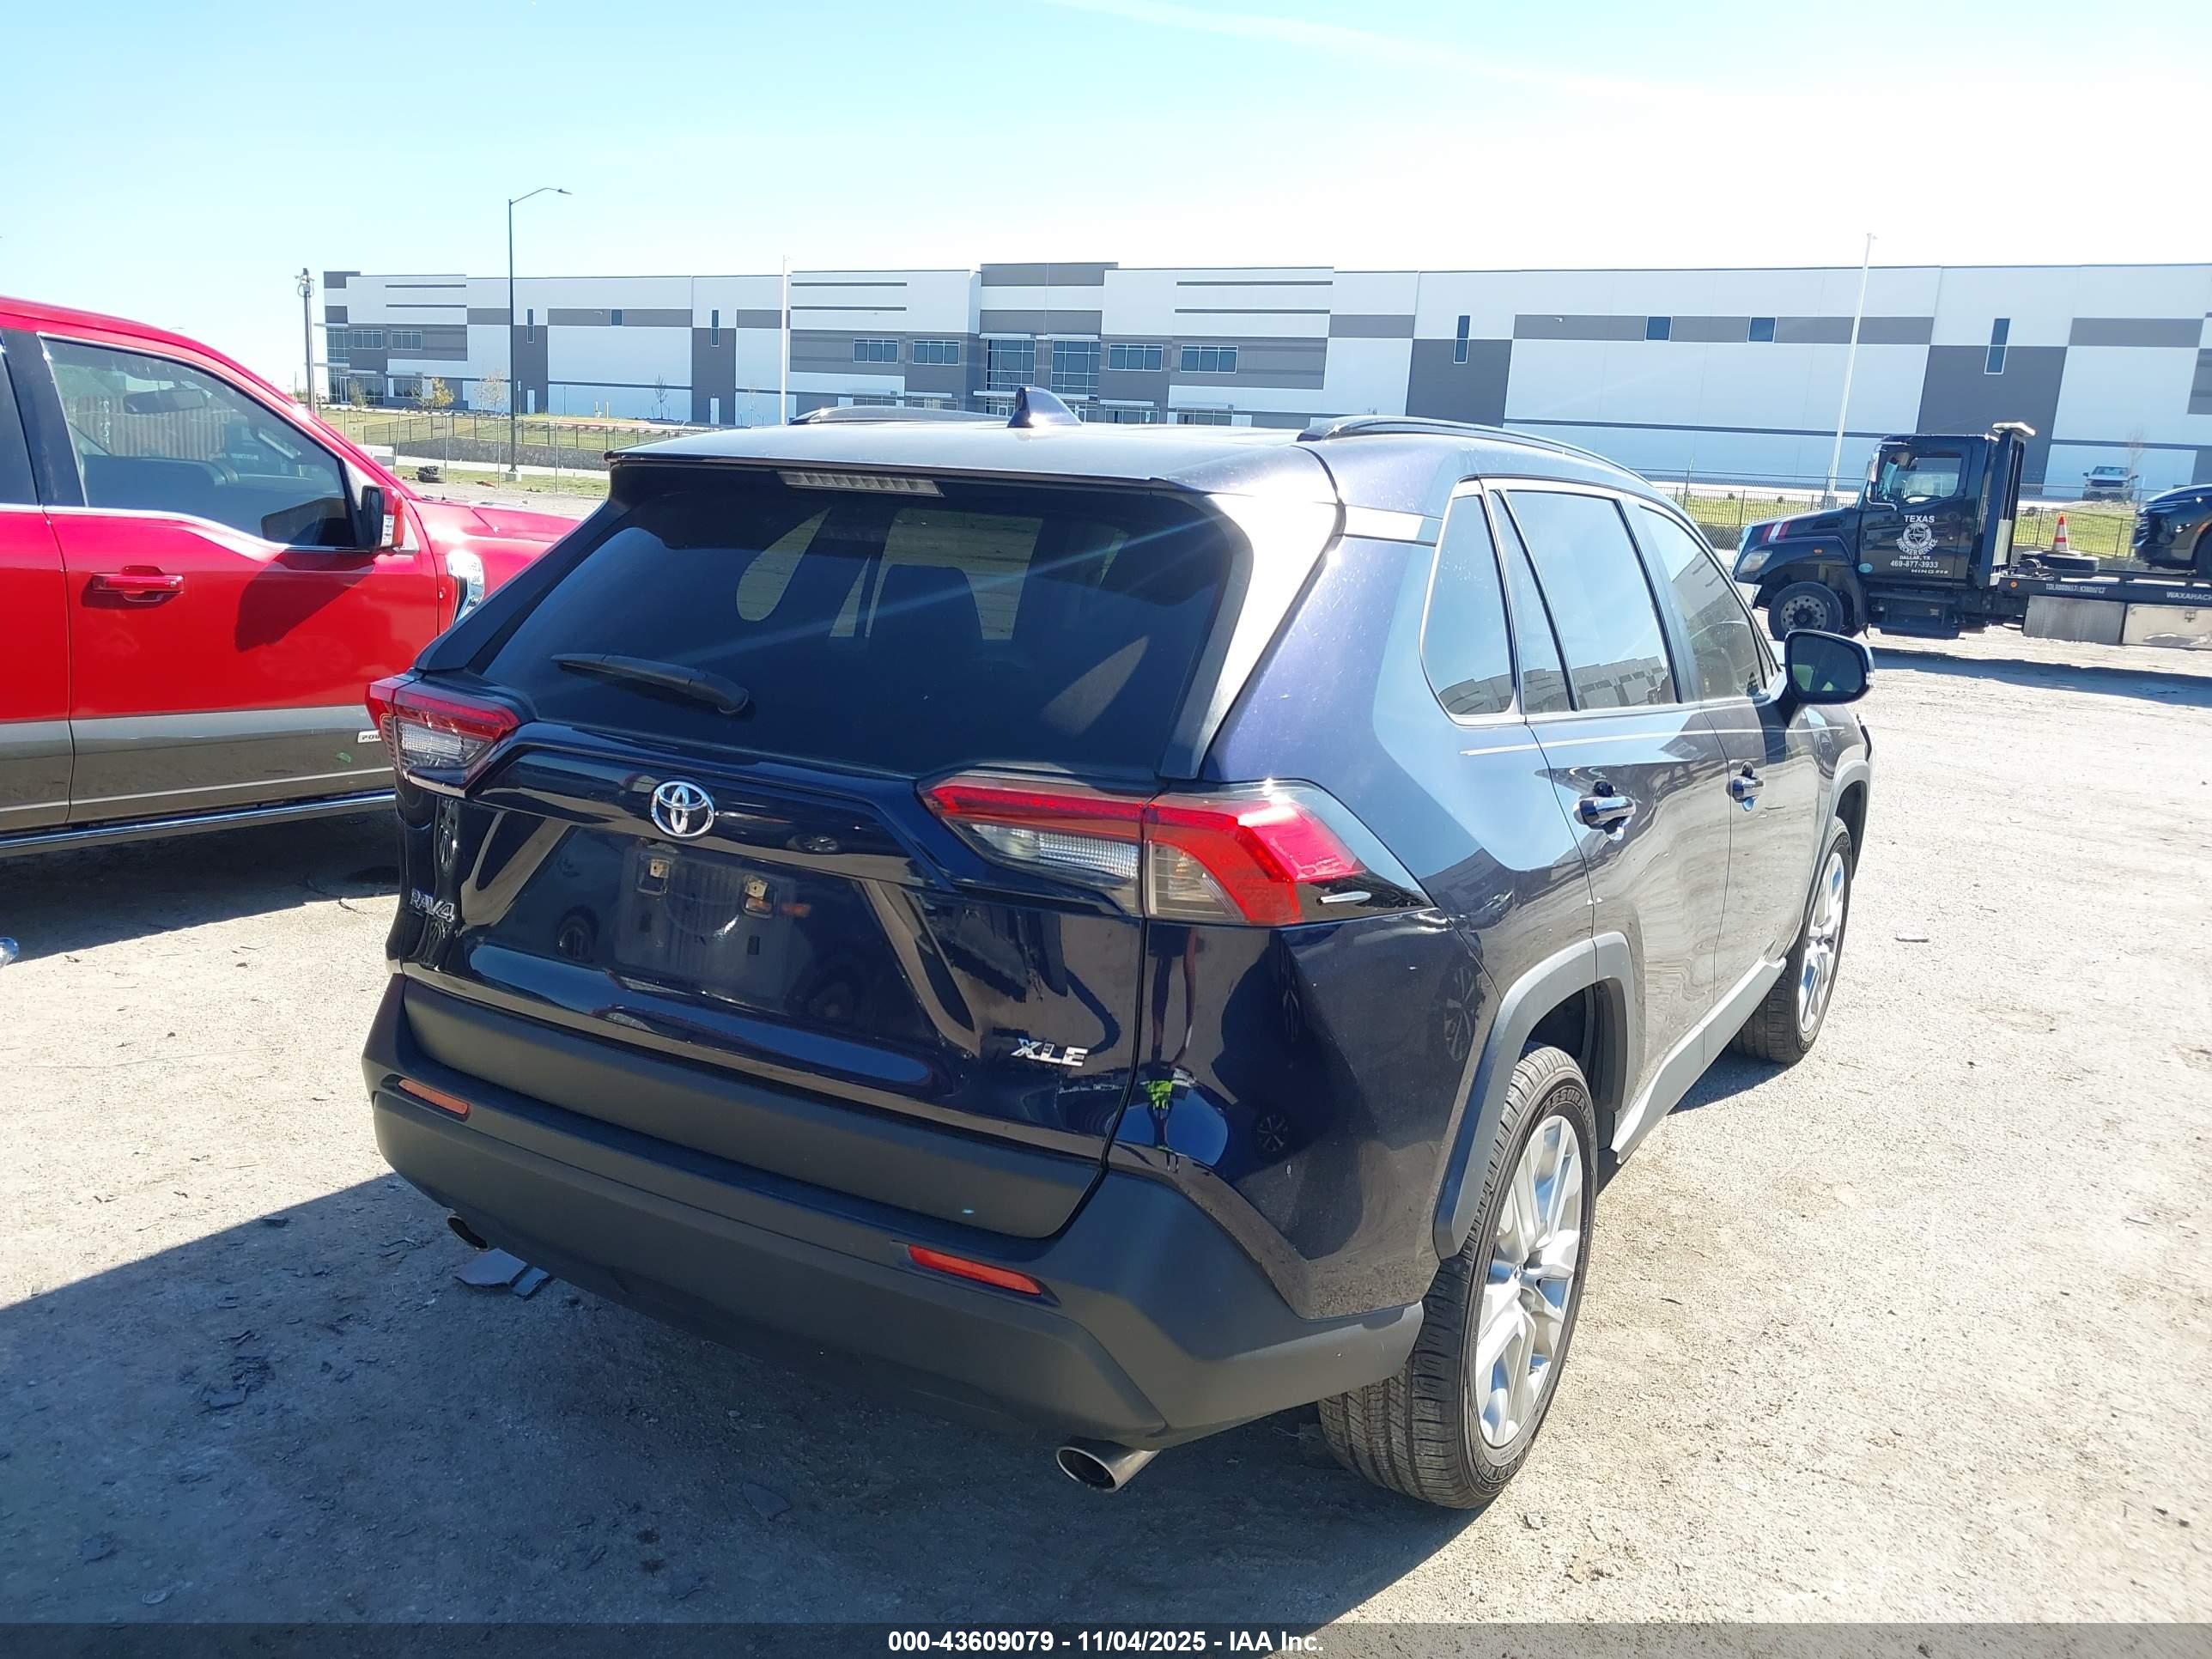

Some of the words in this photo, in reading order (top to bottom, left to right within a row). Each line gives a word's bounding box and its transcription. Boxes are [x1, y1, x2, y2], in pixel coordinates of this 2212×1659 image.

[1895, 537, 1917, 555] WRECKER
[1917, 538, 1938, 556] SERVICE
[410, 888, 455, 923] RAV4
[1011, 1038, 1089, 1066] XLE
